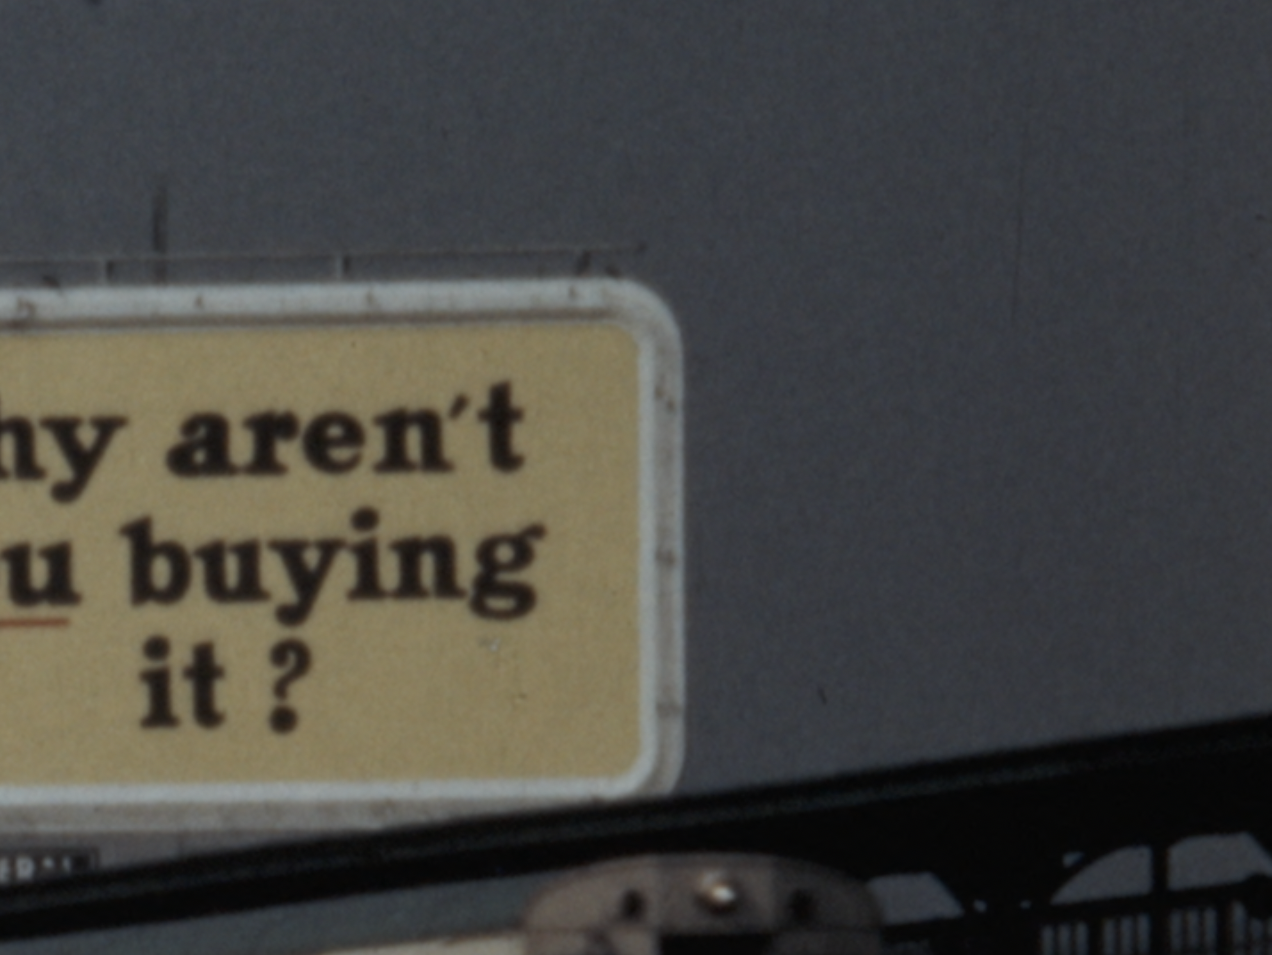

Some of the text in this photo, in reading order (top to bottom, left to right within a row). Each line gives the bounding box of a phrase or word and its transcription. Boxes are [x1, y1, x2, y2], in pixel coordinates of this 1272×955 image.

[165, 382, 525, 476] aren't
[119, 507, 546, 627] buying
[140, 636, 312, 734] it ?
